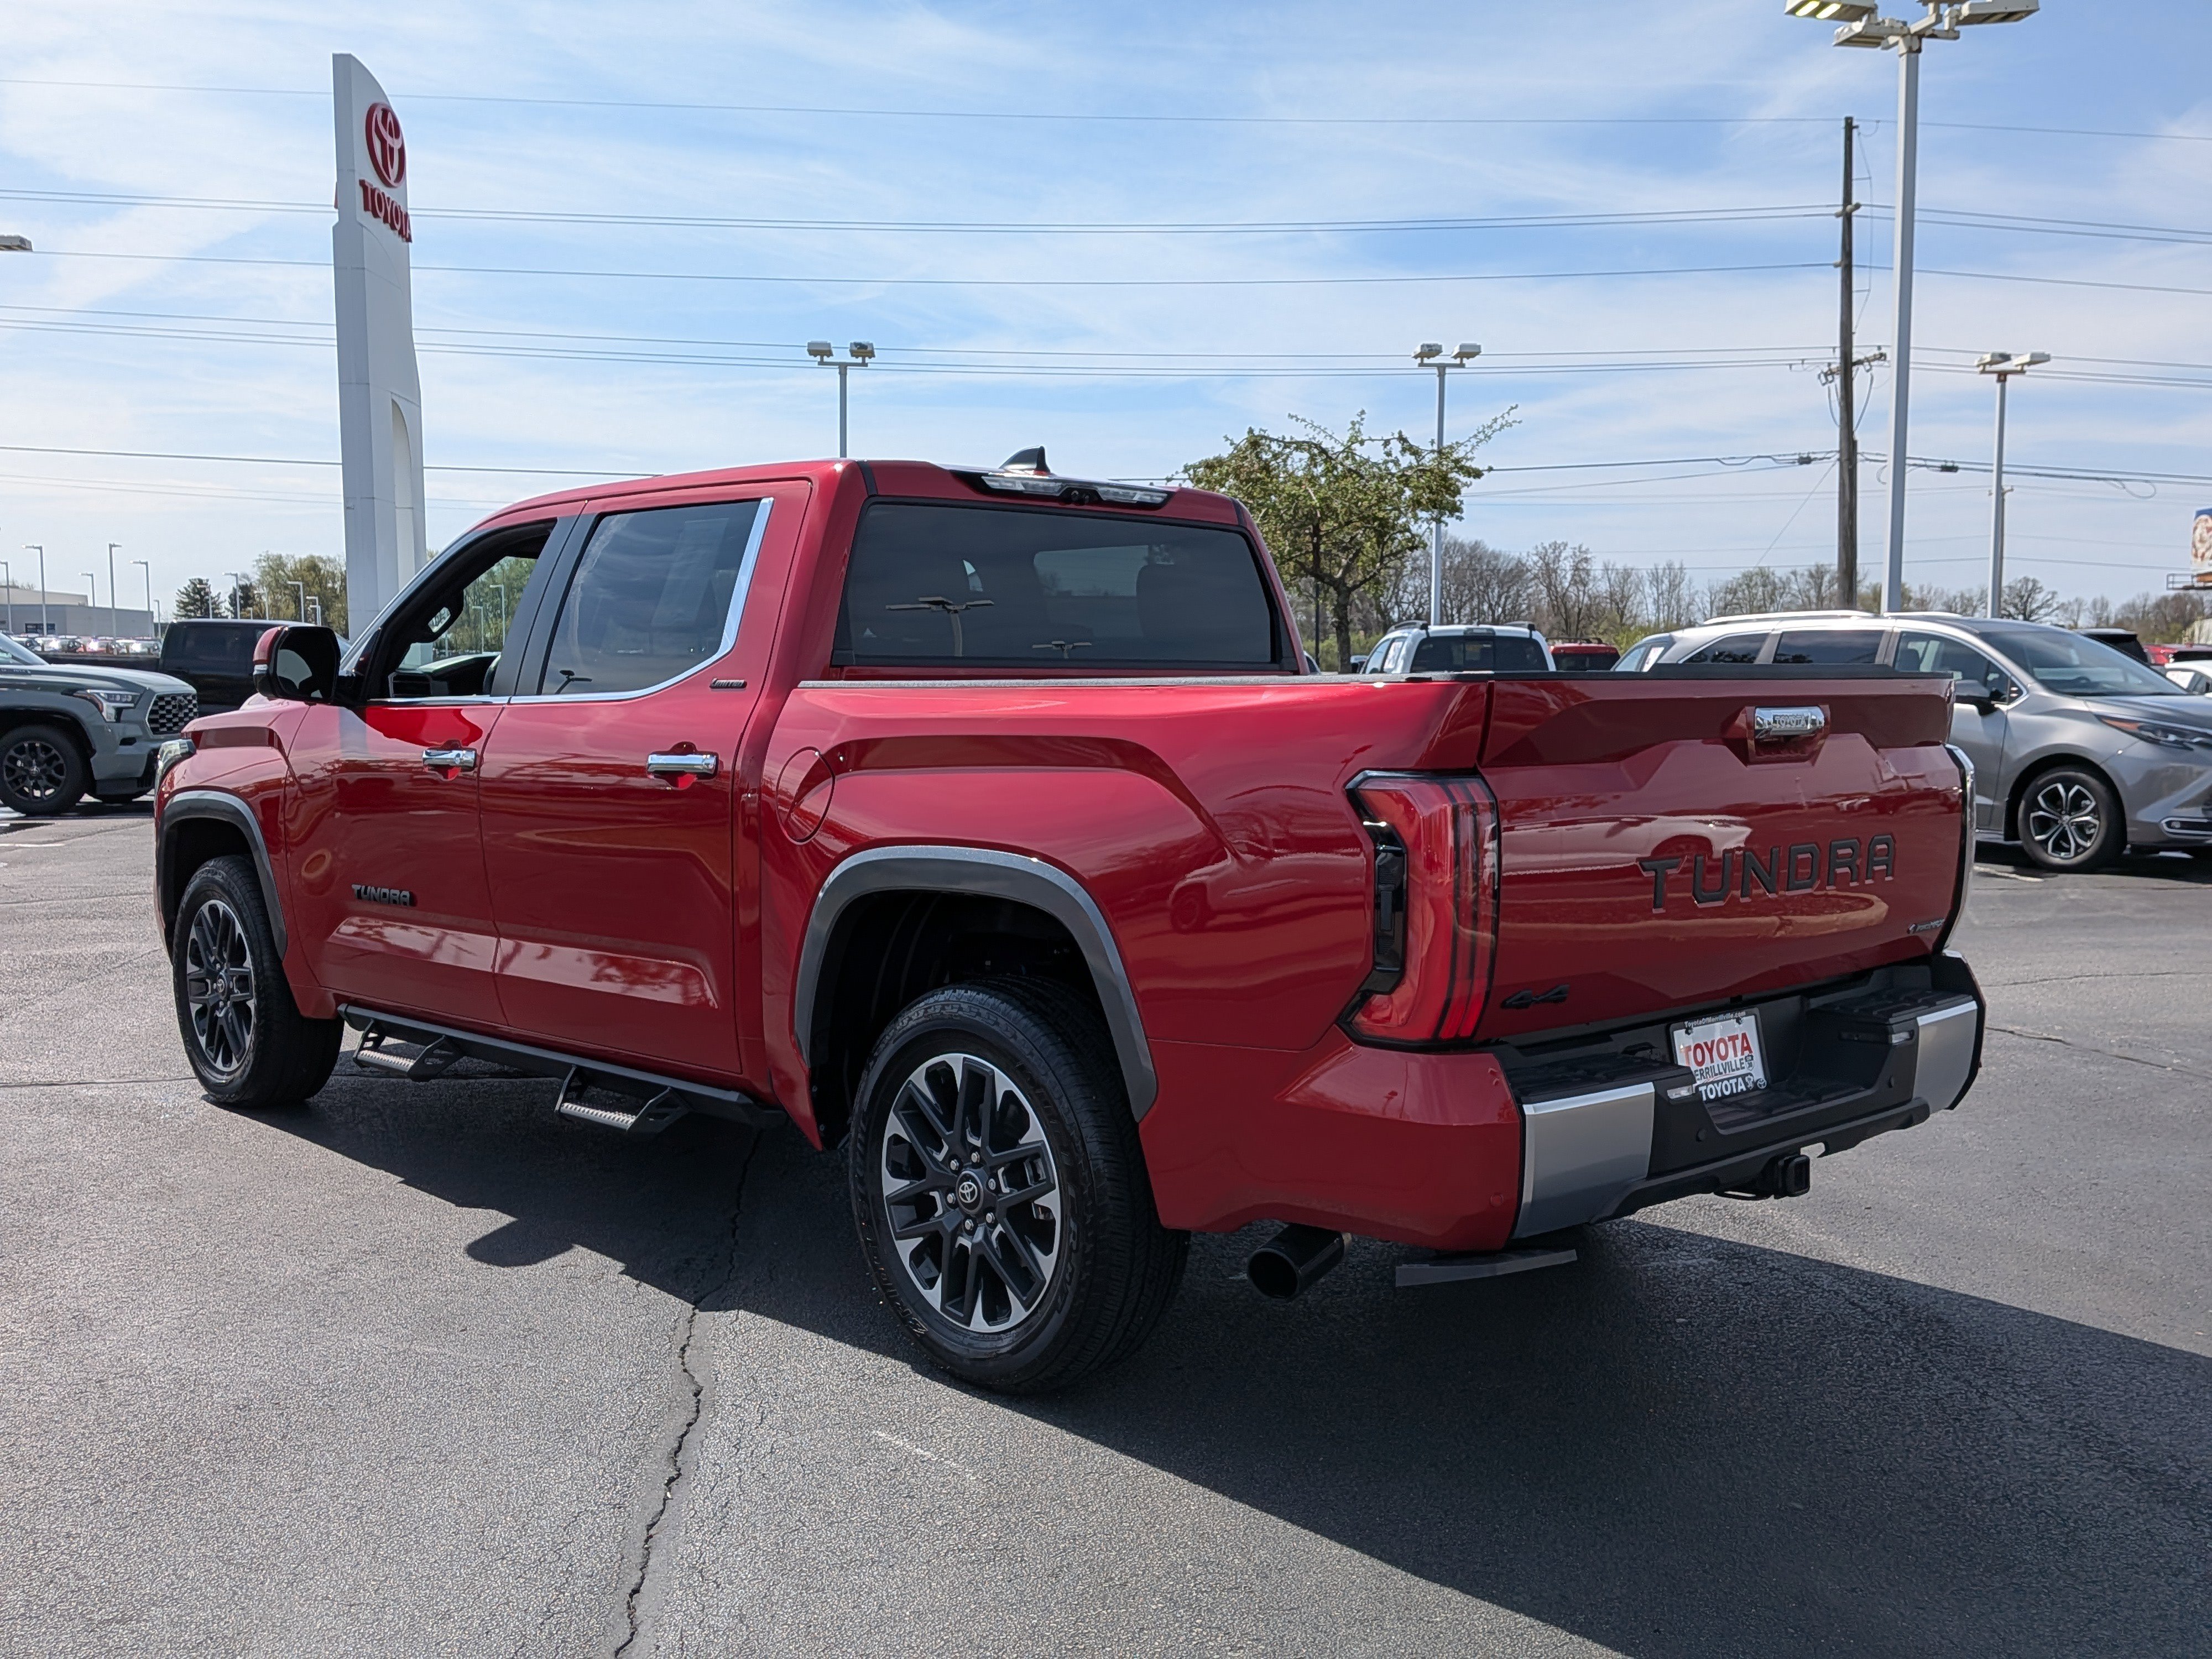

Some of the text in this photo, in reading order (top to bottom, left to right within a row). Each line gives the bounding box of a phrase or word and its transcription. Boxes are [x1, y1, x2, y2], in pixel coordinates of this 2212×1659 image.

[359, 179, 412, 243] TOYOTA
[1774, 716, 1807, 728] TOYOTA
[1636, 834, 1896, 912] TUNDRA
[351, 884, 410, 907] TUNDRA
[1683, 1032, 1753, 1067] TOYOTA
[1694, 1057, 1745, 1081] ERRILLVILLE
[1699, 1077, 1746, 1101] TOYOTA
